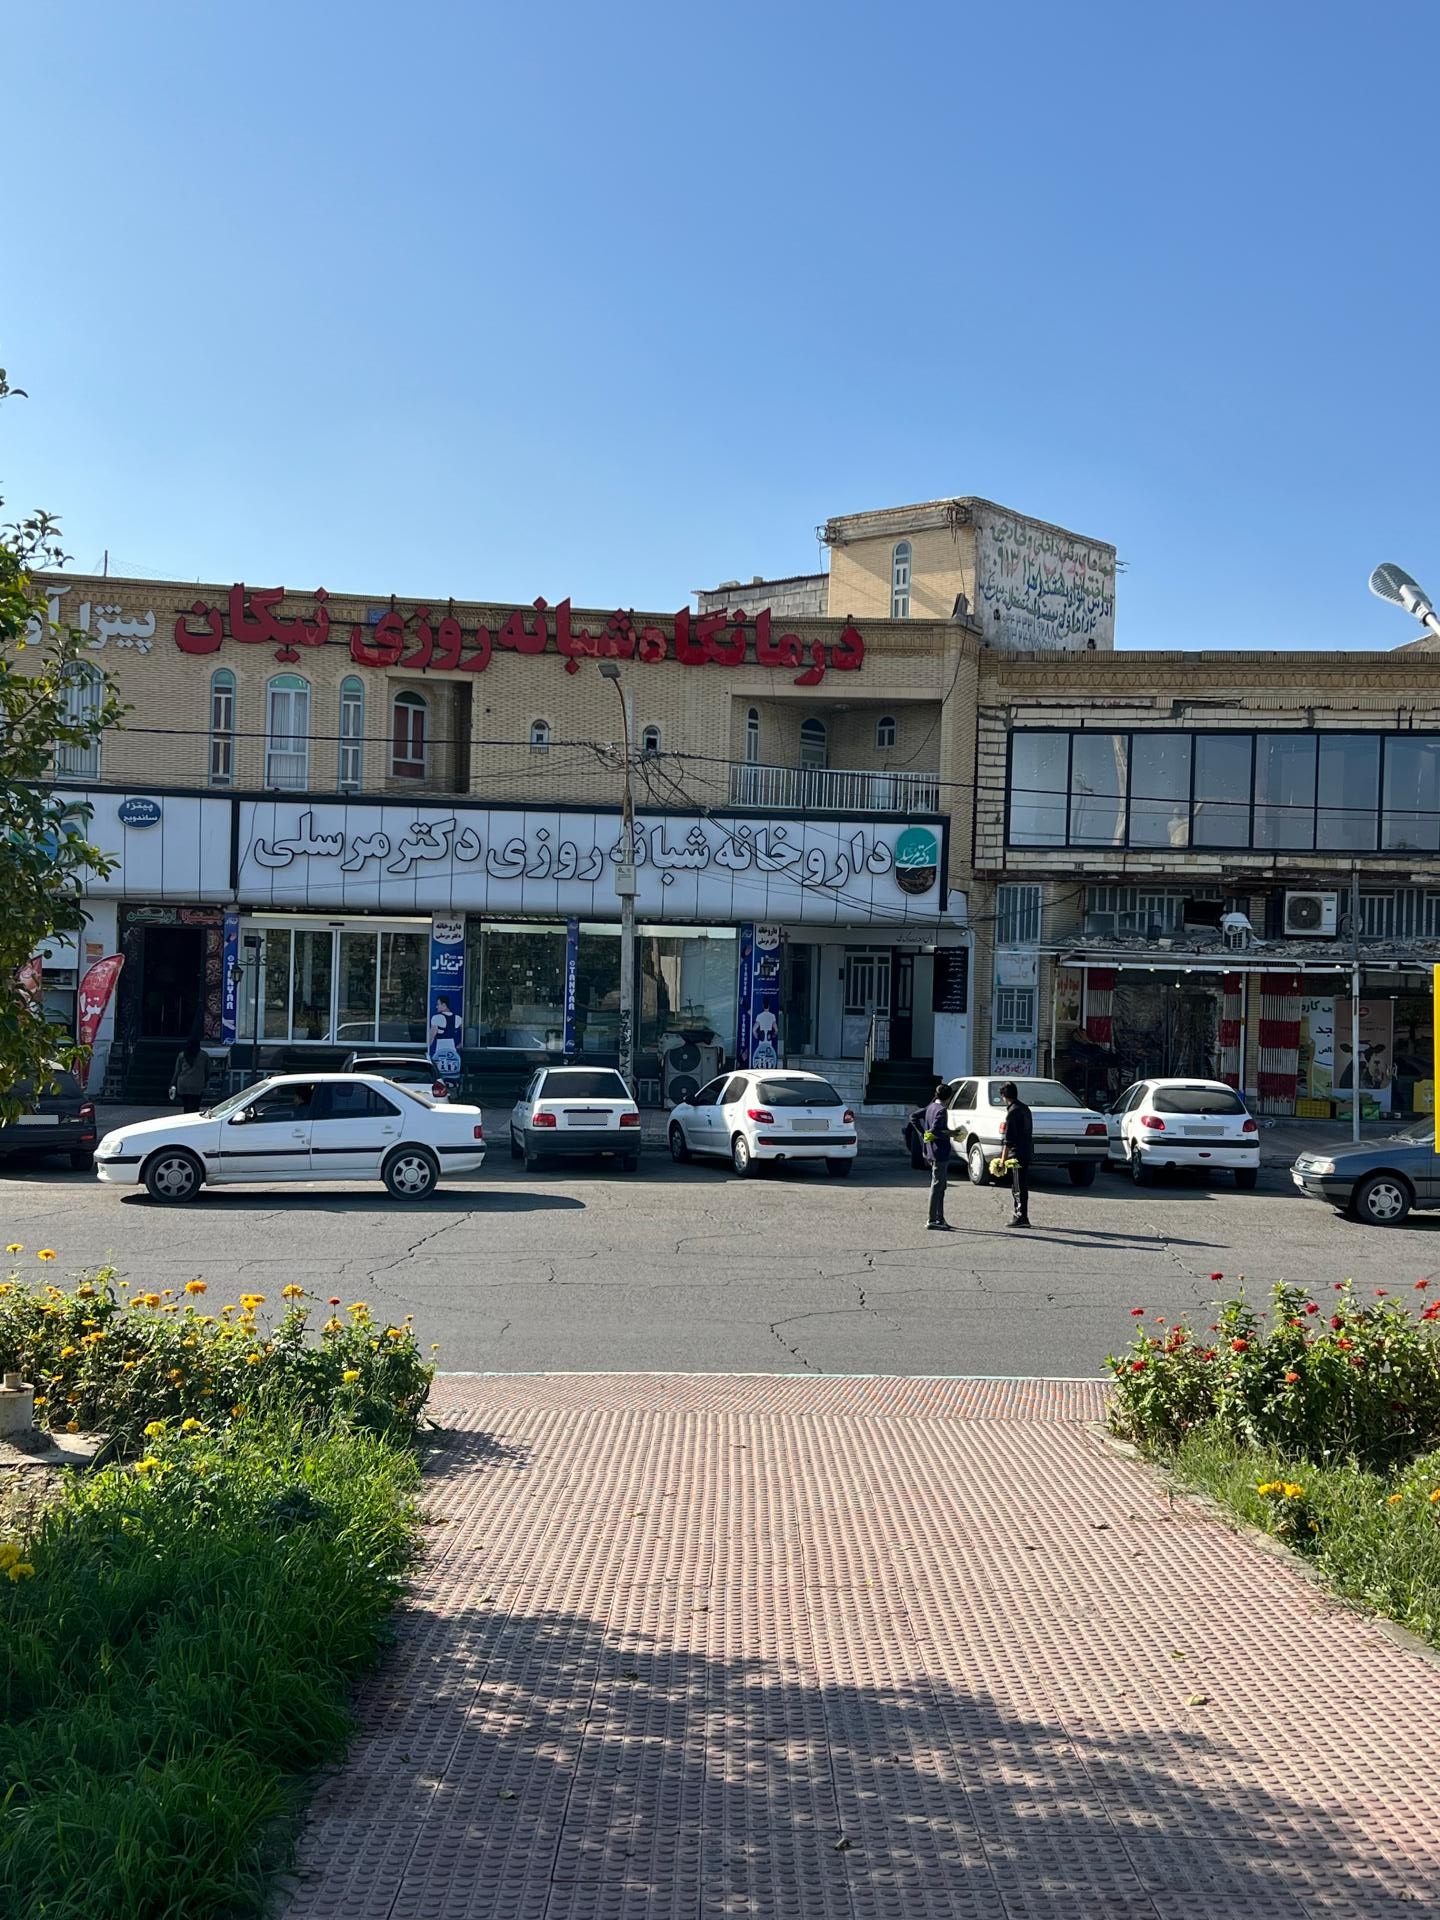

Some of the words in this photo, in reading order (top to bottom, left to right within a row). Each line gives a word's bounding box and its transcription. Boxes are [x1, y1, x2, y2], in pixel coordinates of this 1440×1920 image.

[80, 601, 156, 655] پیتزا
[350, 606, 492, 672] روزی
[498, 596, 636, 675] شبانه
[638, 605, 864, 686] درمانگاه
[254, 810, 391, 872] مرسلی
[386, 817, 481, 873] دکتر
[486, 827, 604, 881] روزی
[609, 820, 711, 886] شبانه
[714, 824, 892, 888] داروخانه
[435, 923, 462, 932] داروخانه
